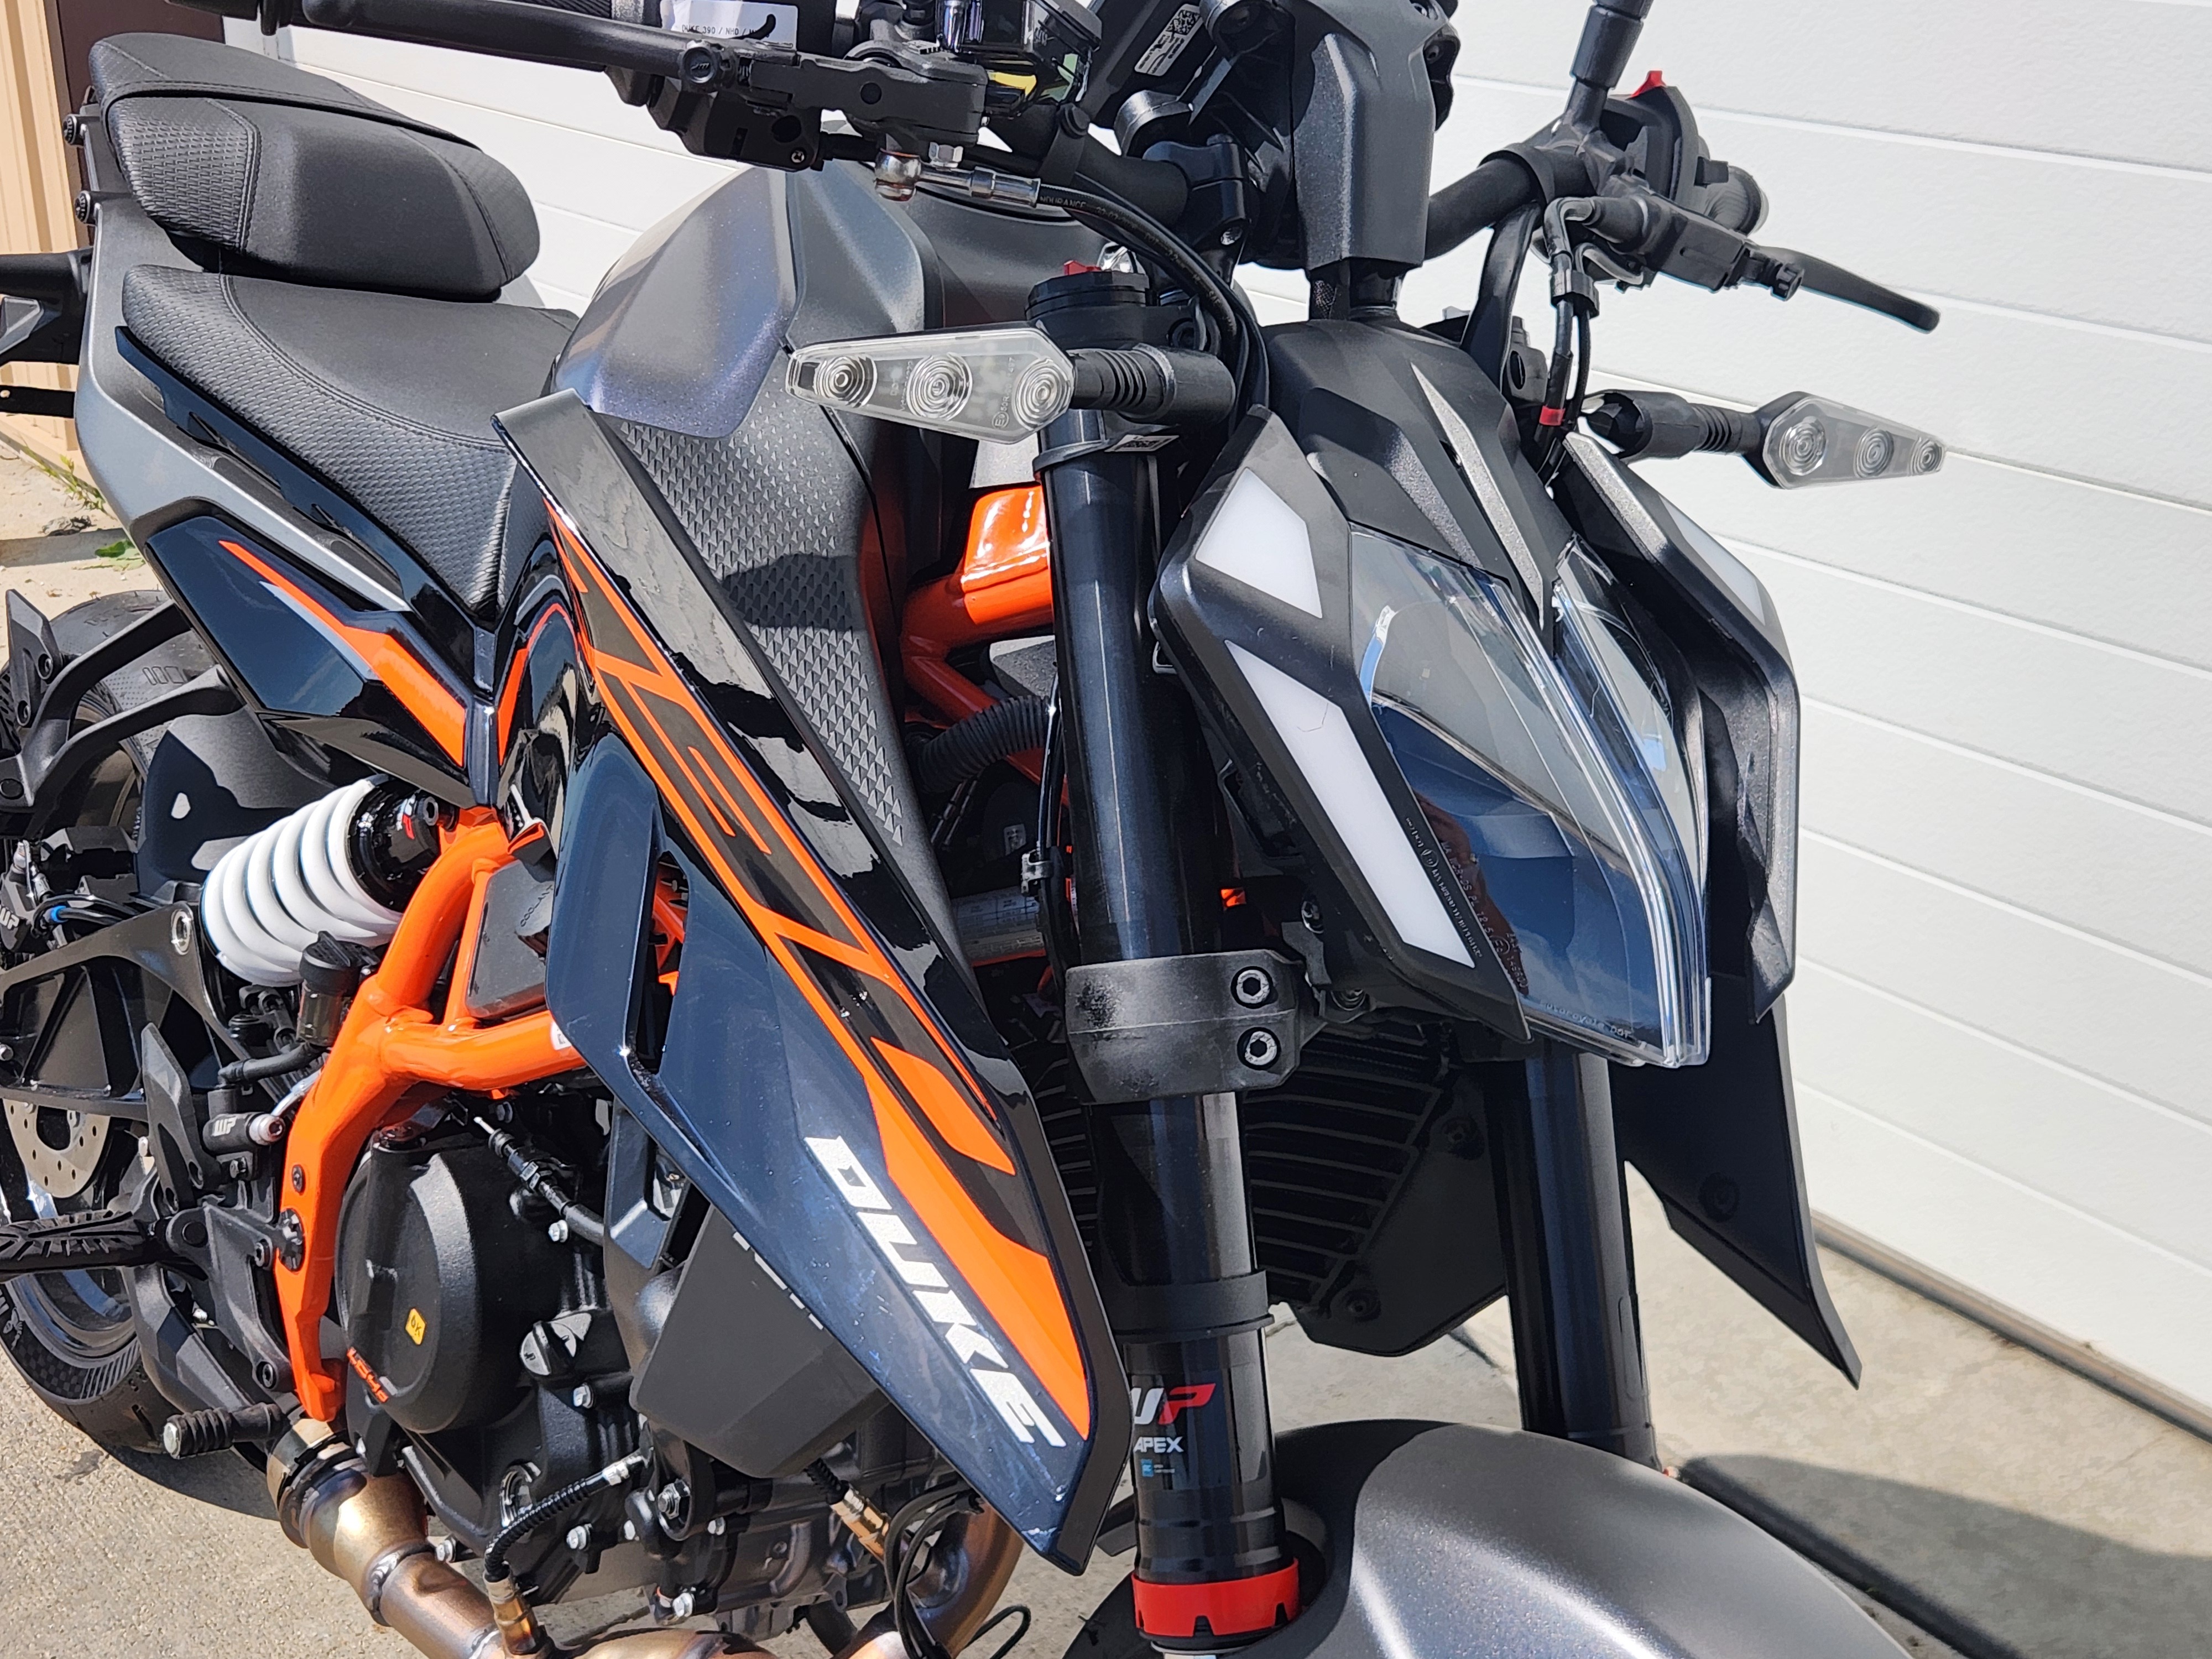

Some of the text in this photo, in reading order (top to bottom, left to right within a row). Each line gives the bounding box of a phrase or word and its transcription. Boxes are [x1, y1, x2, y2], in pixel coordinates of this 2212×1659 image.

[702, 26, 716, 34] 390
[1040, 196, 1087, 208] NDURANCE
[520, 884, 553, 927] COOLANT
[212, 1115, 237, 1137] WP
[804, 1135, 1067, 1448] DUKE
[411, 1314, 422, 1337] OK
[1133, 1436, 1185, 1453] APEX
